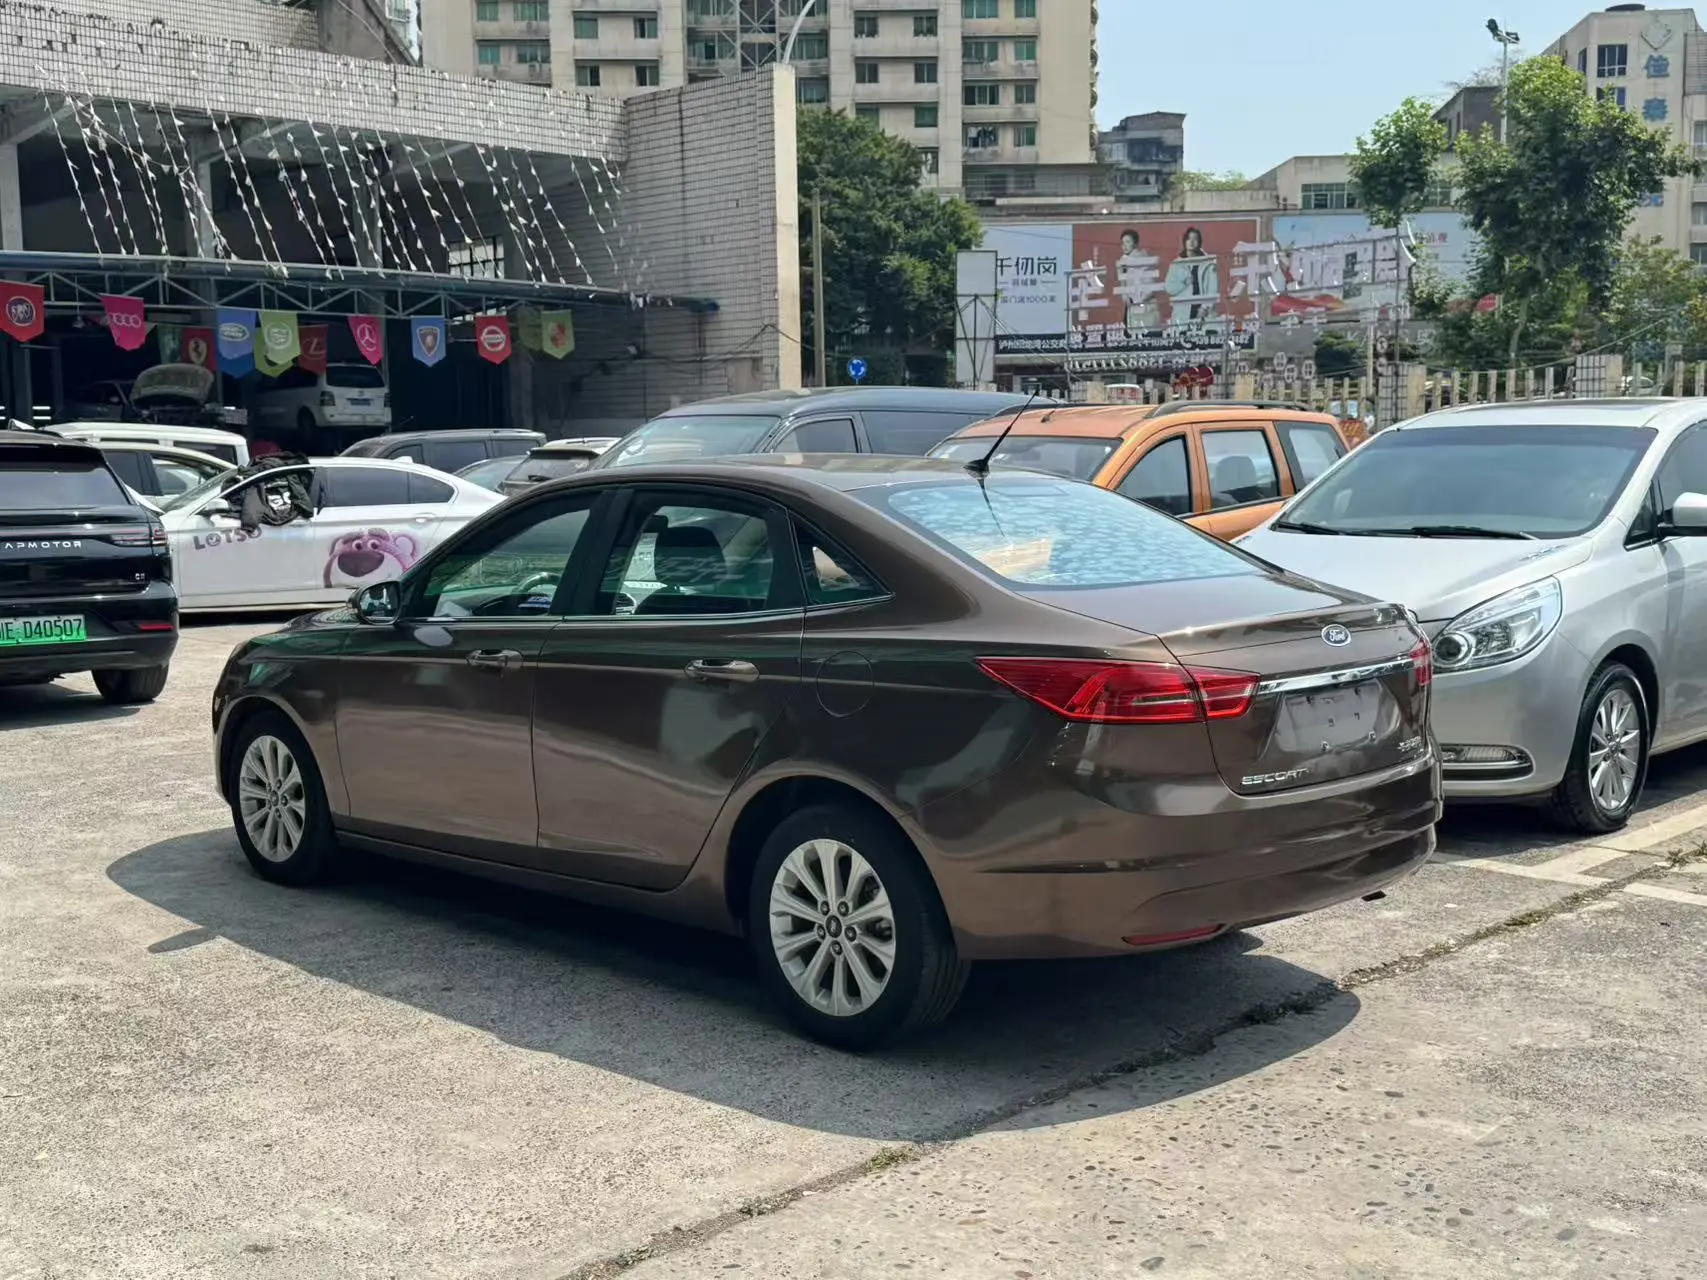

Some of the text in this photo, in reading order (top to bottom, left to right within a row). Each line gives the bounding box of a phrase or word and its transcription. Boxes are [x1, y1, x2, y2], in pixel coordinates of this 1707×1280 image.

[998, 256, 1057, 276] 千仞岗
[24, 618, 82, 639] D40507
[1241, 767, 1309, 785] ESCORT
